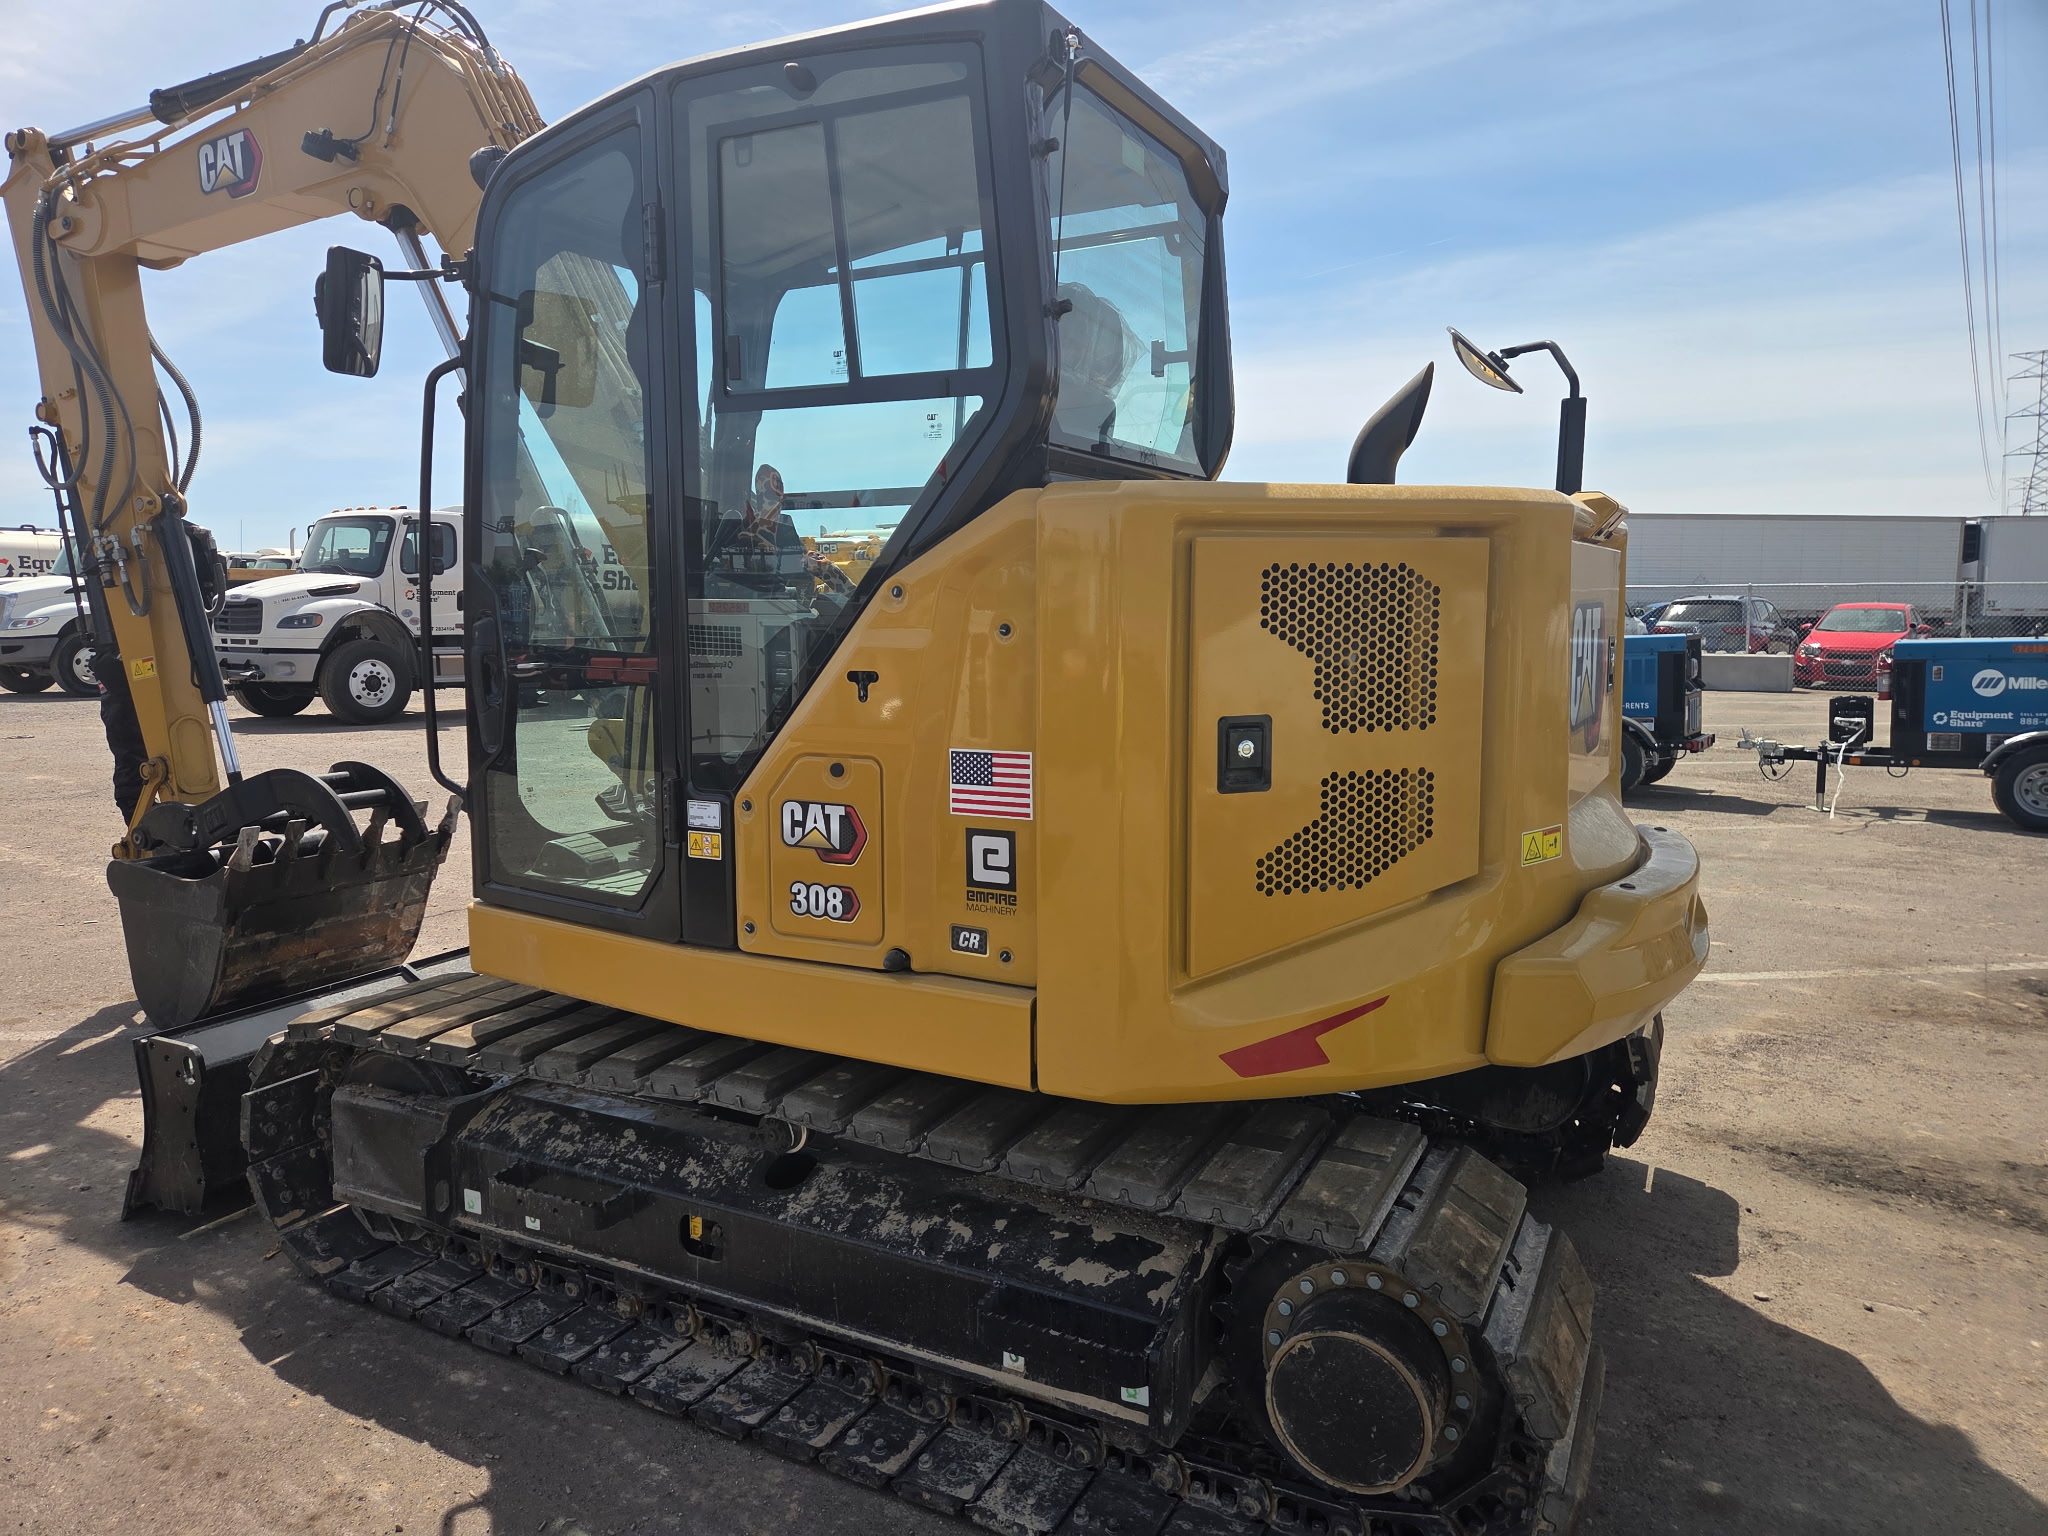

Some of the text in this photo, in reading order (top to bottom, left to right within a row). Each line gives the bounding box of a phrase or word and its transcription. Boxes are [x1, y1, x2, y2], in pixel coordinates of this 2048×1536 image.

[199, 131, 244, 192] CAT
[1571, 608, 1601, 726] CAT
[1949, 719, 1984, 727] Share
[1950, 711, 2014, 720] Equipment
[782, 801, 846, 850] CAT
[791, 882, 843, 919] 308
[966, 903, 1017, 917] MACHINERY
[958, 931, 980, 949] CR
